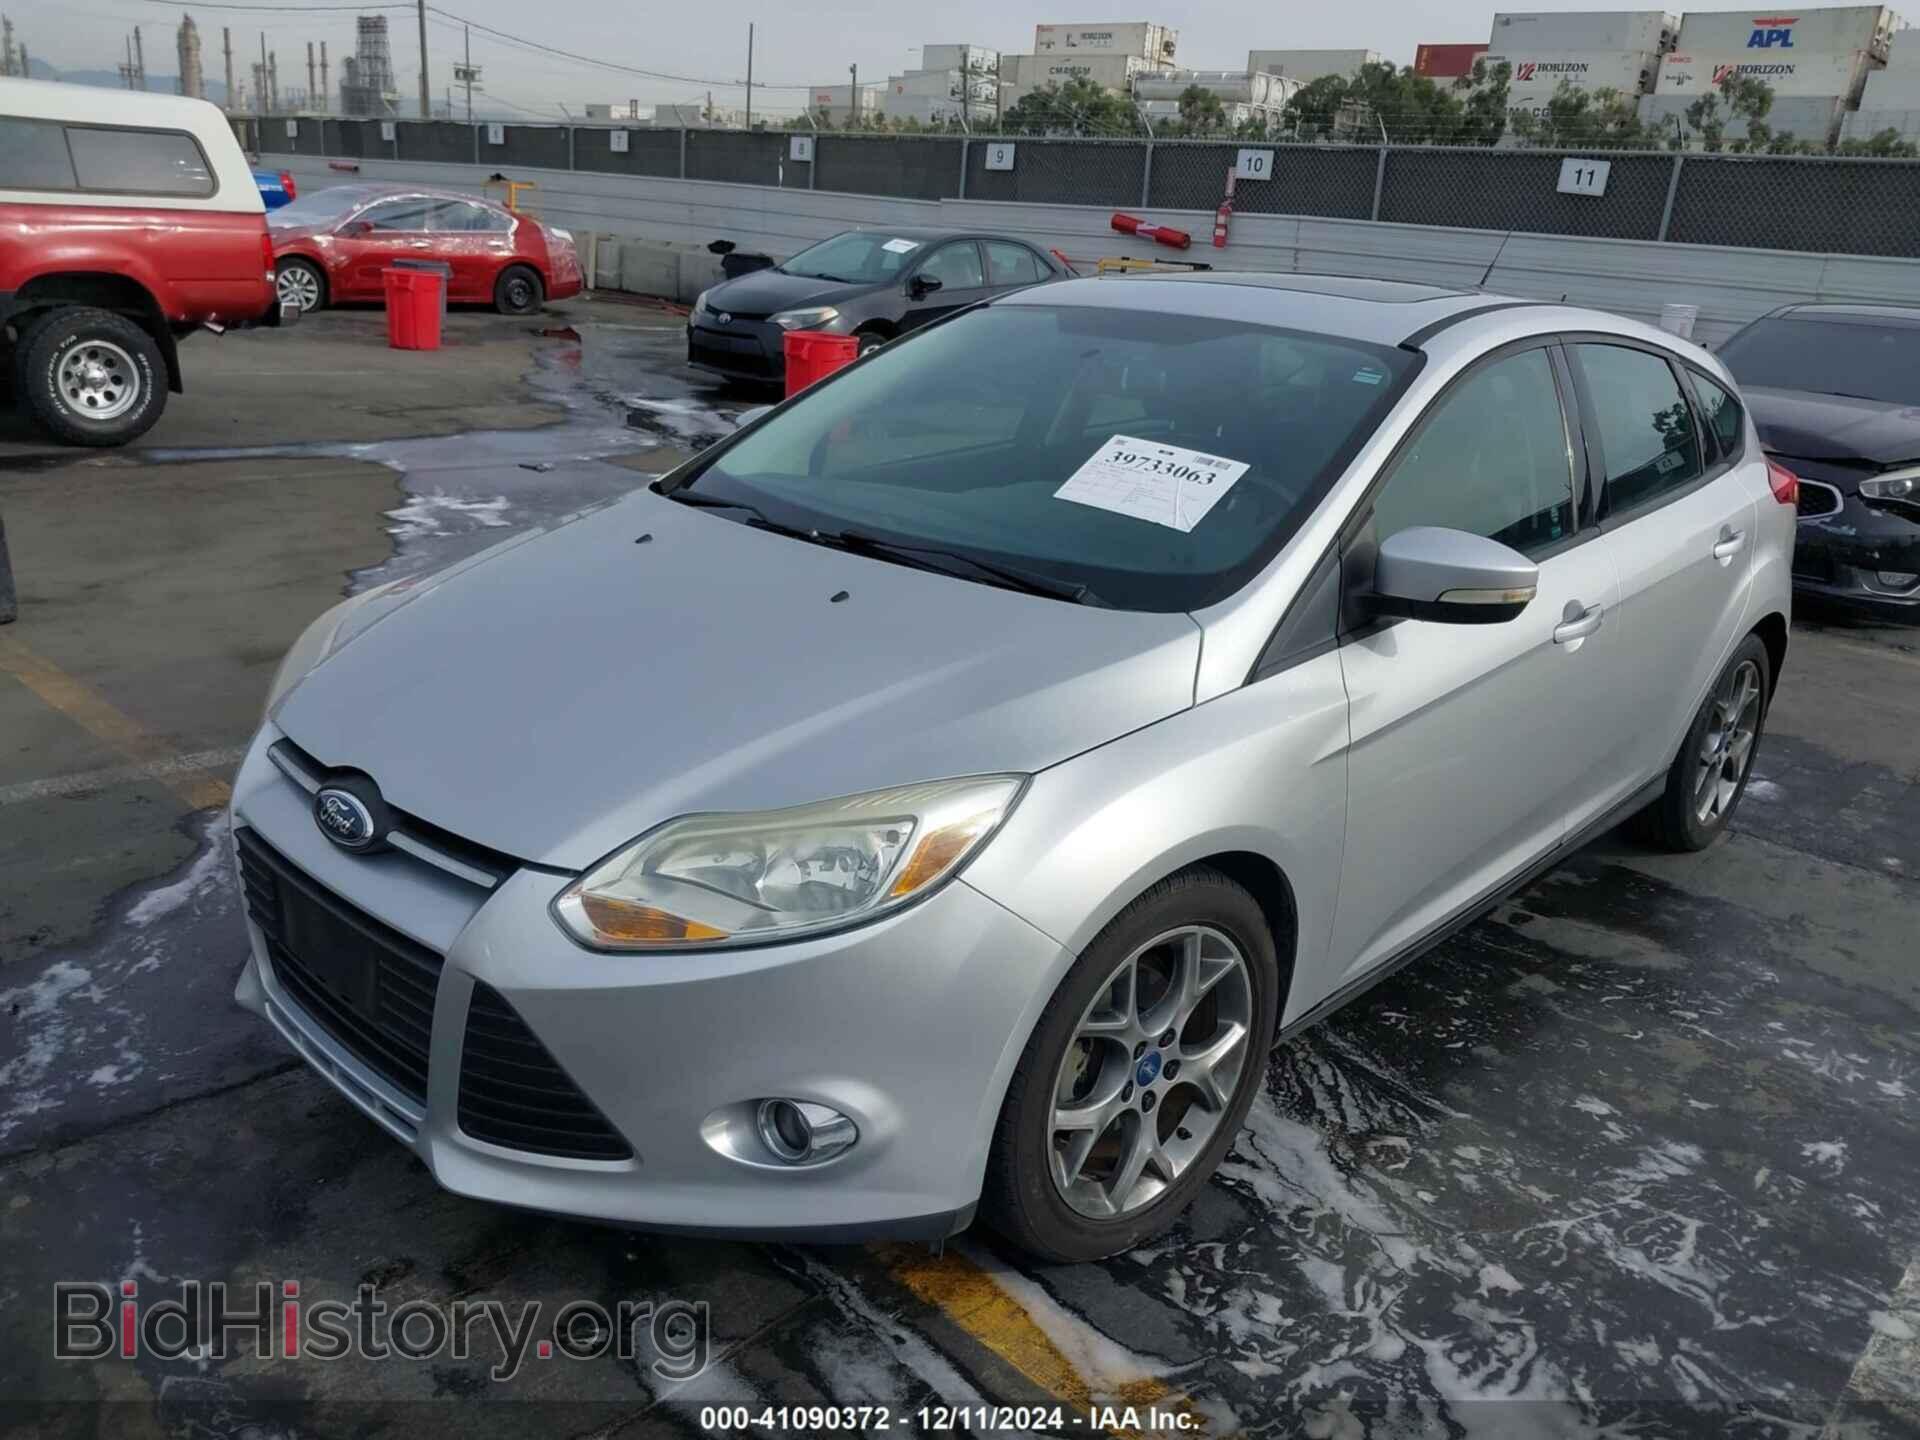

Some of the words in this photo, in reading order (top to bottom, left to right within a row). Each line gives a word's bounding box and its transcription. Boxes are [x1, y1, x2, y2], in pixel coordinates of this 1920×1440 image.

[1747, 28, 1794, 48] APL
[1537, 63, 1588, 73] HORIZON
[1736, 64, 1795, 74] HORIZON
[996, 150, 1004, 163] 9
[1247, 157, 1263, 172] 10
[1575, 168, 1595, 186] 11
[1104, 451, 1217, 486] 39733063
[320, 796, 356, 835] Ford
